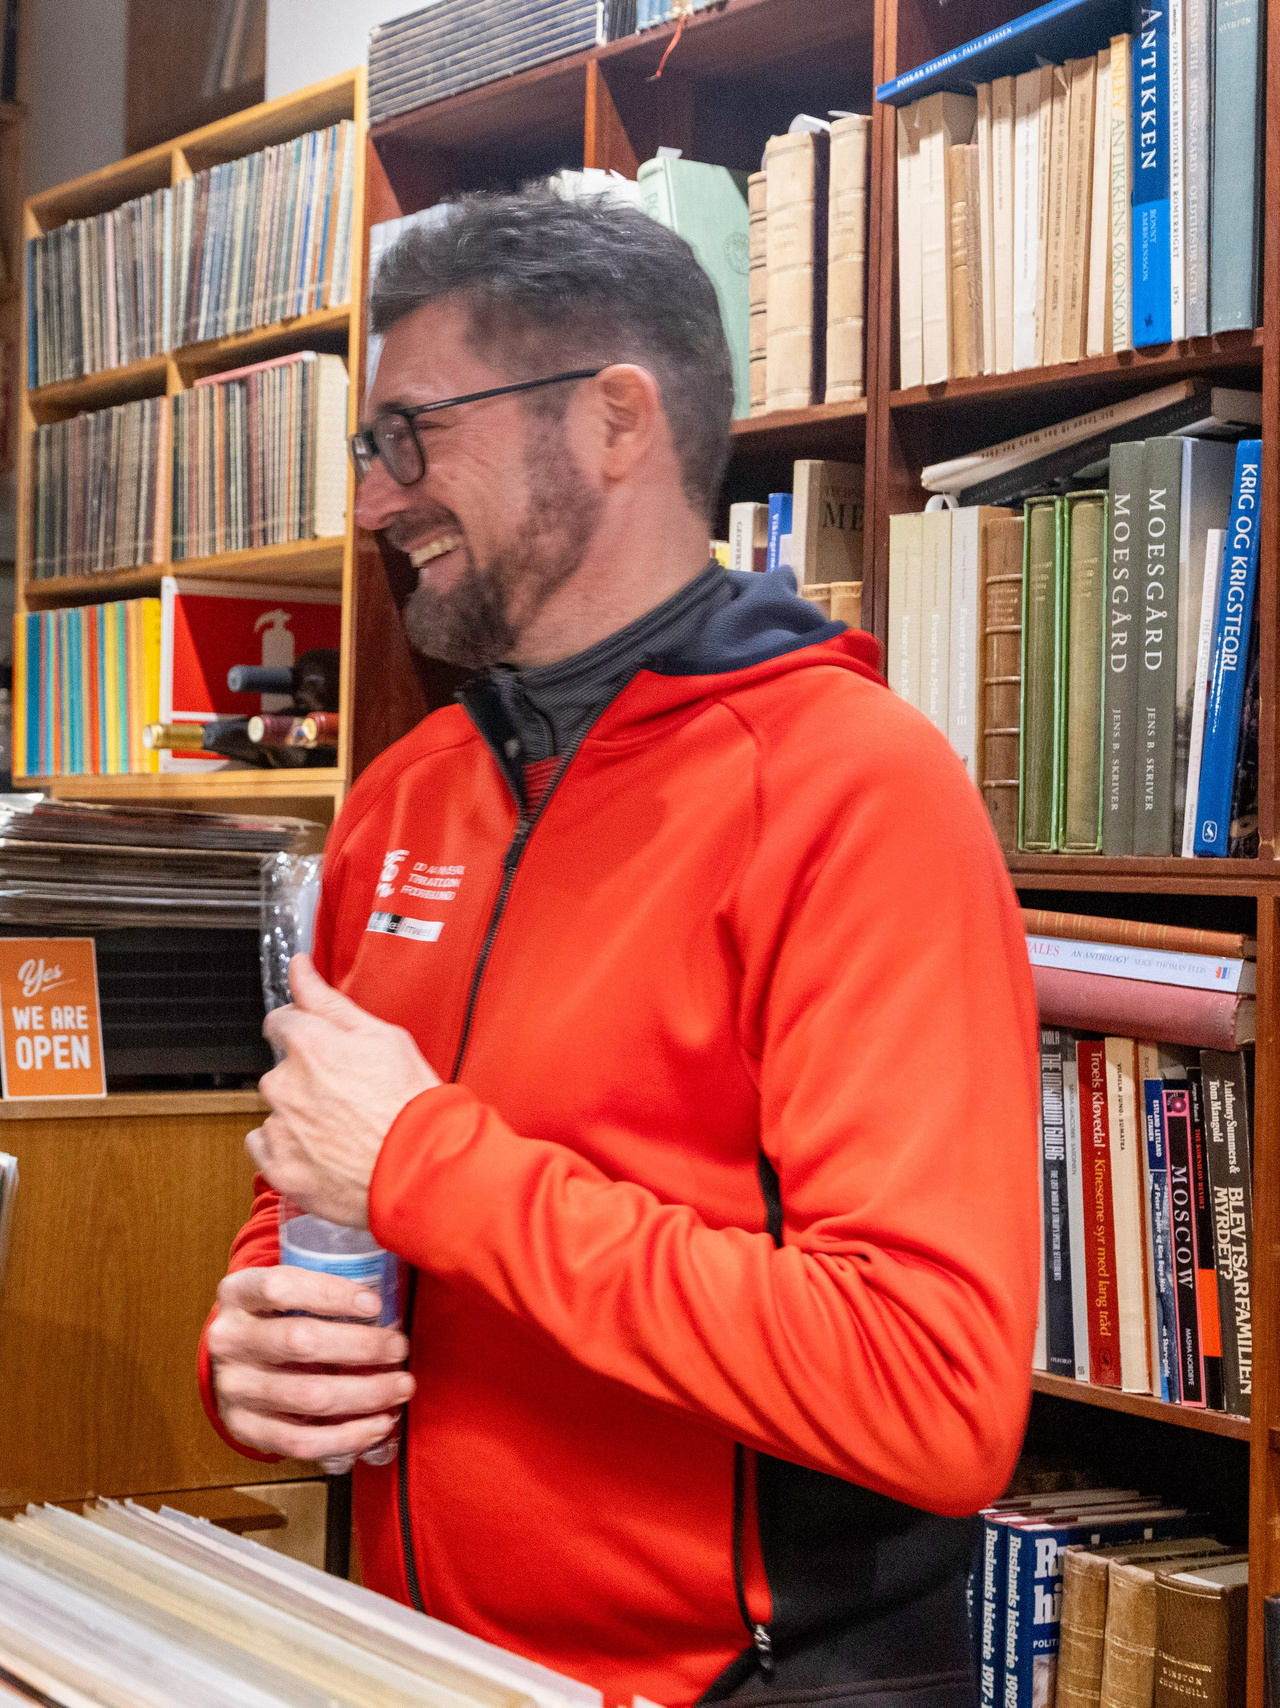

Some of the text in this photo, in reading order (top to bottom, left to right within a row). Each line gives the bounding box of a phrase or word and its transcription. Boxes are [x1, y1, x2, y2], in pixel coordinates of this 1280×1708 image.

[923, 52, 957, 74] STENHUS
[960, 40, 983, 56] PALLE
[982, 25, 1013, 45] ERIKSEN
[1140, 7, 1163, 169] ANTIKKEN
[1110, 117, 1127, 236] ANTIKKENS
[1171, 112, 1179, 178] BIBLIOTEKER
[1112, 243, 1129, 347] ØKONOMI
[1111, 491, 1131, 673] MOESGÅRD
[1145, 486, 1168, 670] MOESGÅRD
[1223, 463, 1257, 671] KRIG OG KRIGSTEORI
[929, 614, 939, 654] Eventyr
[958, 608, 967, 648] Eventyr
[1202, 618, 1210, 636] THE
[929, 676, 938, 713] Jylland
[930, 657, 938, 672] fra
[957, 672, 966, 709] Jylland
[1110, 709, 1120, 810] JENS B. SKRIVER
[1143, 707, 1155, 810] JENS B. SKRIVER
[18, 959, 63, 997] Yes
[1071, 950, 1083, 958] AN
[1084, 950, 1128, 964] ANTHOLOGY
[1133, 958, 1152, 967] ALICE
[1155, 960, 1185, 971] THOMAS
[1187, 964, 1206, 974] ELLIS
[12, 1005, 89, 1030] WE ARE
[1041, 1030, 1060, 1045] VIOLA
[16, 1035, 91, 1070] OPEN
[1041, 1053, 1064, 1160] THE UNKNOWN GULAG
[1146, 1114, 1154, 1141] LITAUEN
[1152, 1099, 1162, 1157] ESTLAND LETLAND
[1208, 1079, 1223, 1142] Tom Mangold
[1221, 1079, 1240, 1174] Anthony Summers &
[1090, 1051, 1110, 1336] Troels Kløvedal Kineserne syr med lang tråd
[1155, 1234, 1161, 1243] og
[1171, 1164, 1193, 1289] MOSCOW
[1213, 1186, 1232, 1280] MYRDET?
[1229, 1187, 1252, 1394] BLEV TSARFAMILIEN
[984, 1528, 998, 1600] Ruslands
[1008, 1534, 1022, 1608] Ruslands
[983, 1600, 996, 1661] historie
[1005, 1608, 1020, 1669] historie
